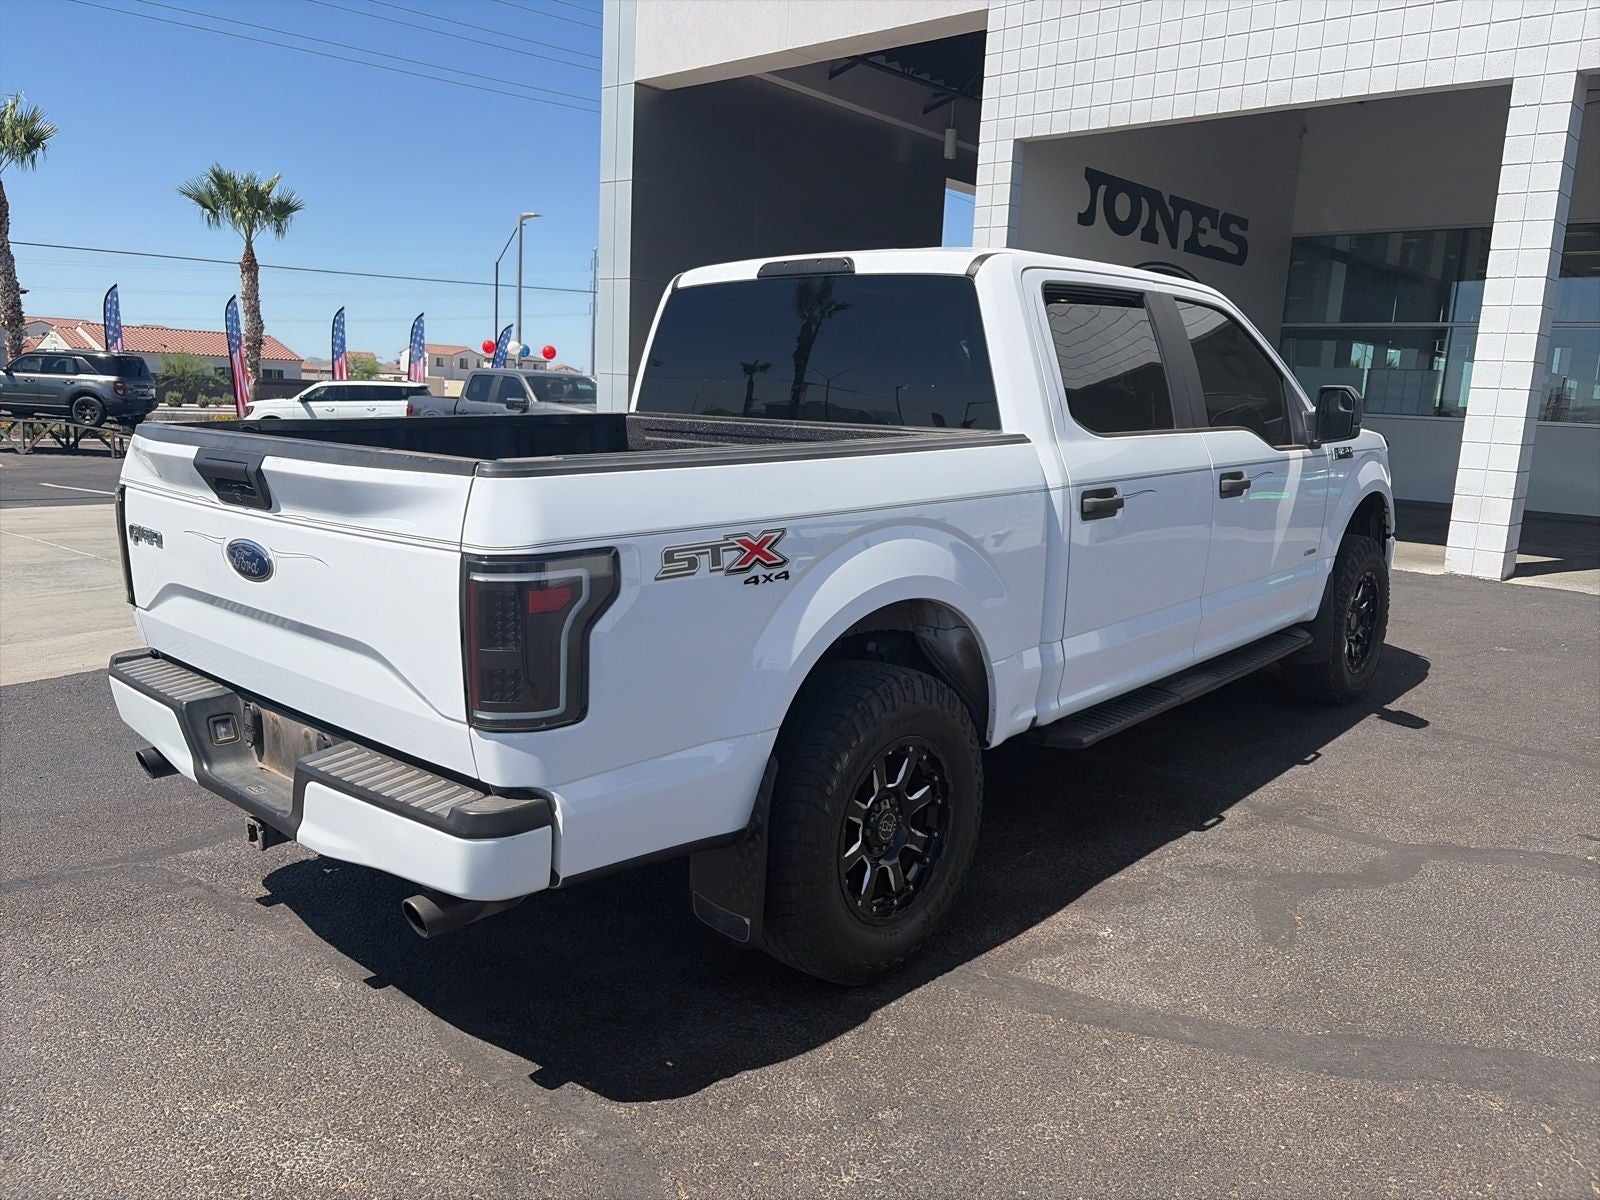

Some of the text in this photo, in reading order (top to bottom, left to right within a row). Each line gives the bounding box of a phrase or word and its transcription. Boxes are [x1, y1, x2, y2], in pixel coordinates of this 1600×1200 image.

[1077, 166, 1249, 266] JONES
[233, 547, 260, 575] Ford
[655, 528, 789, 581] STX
